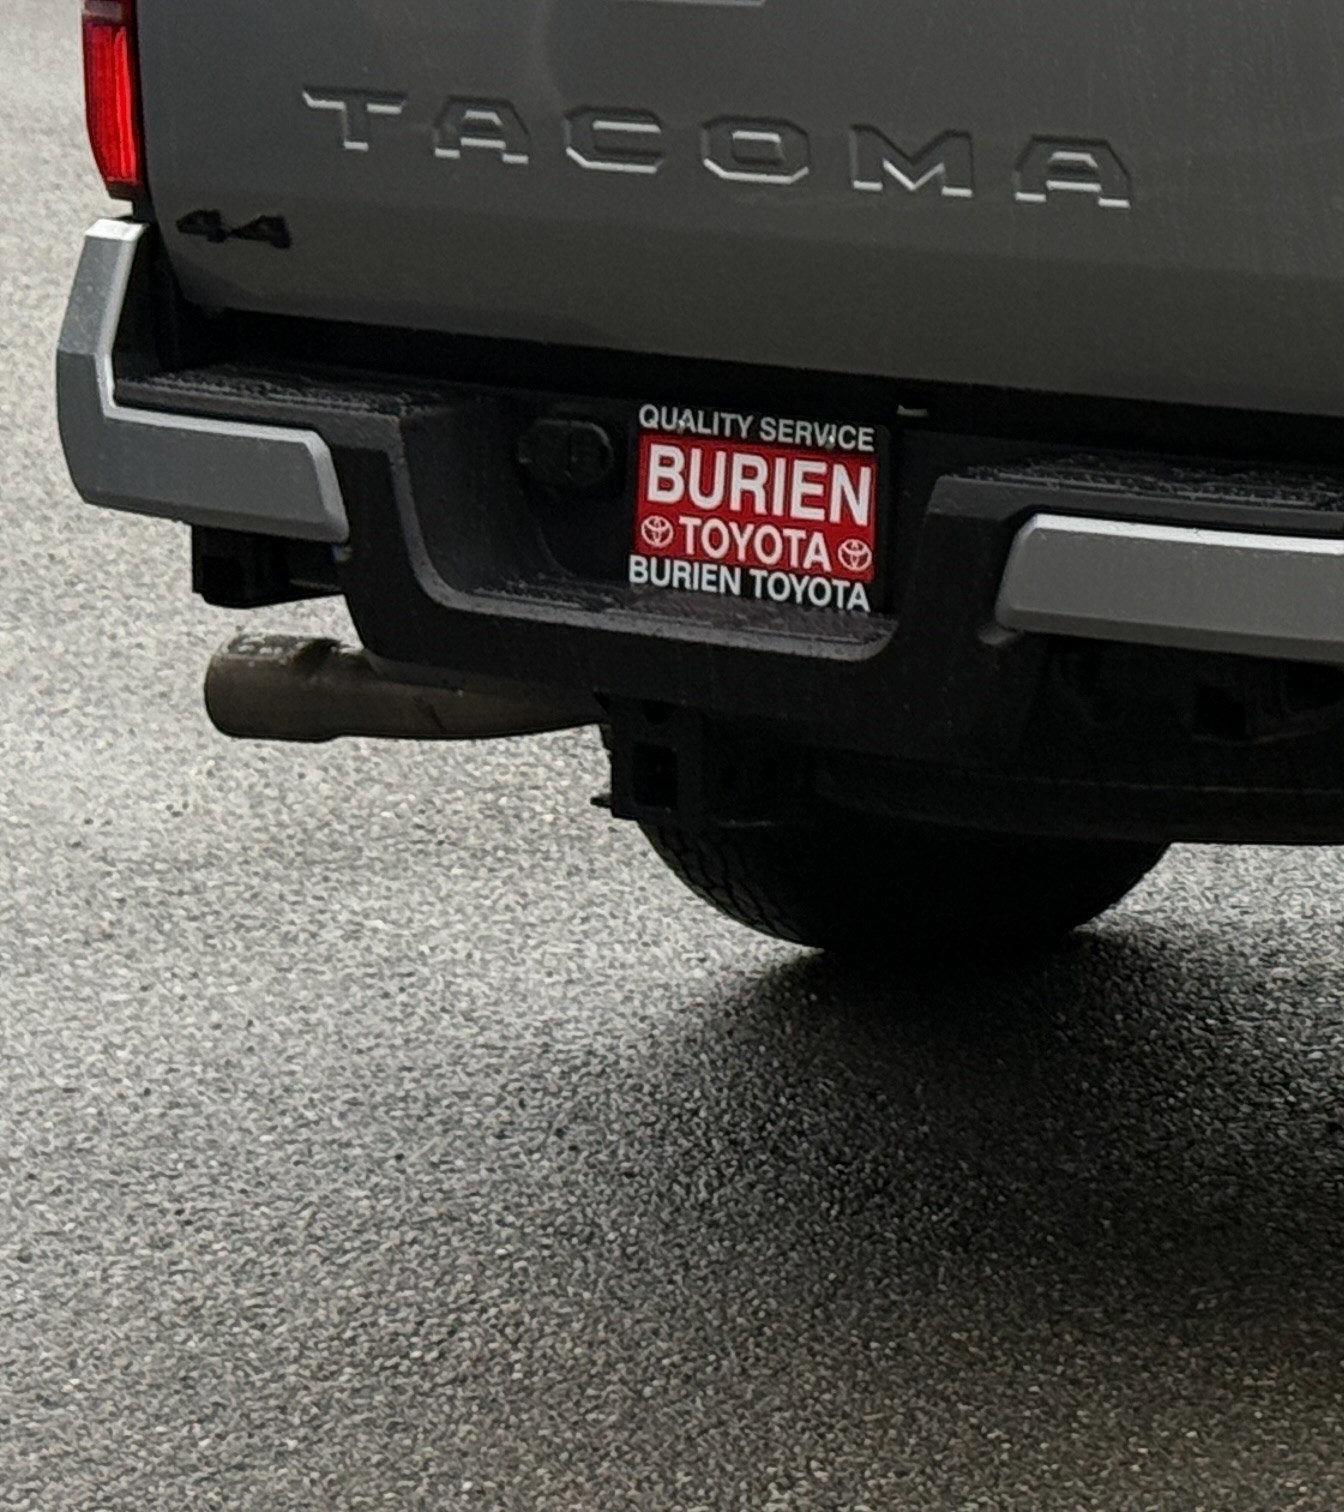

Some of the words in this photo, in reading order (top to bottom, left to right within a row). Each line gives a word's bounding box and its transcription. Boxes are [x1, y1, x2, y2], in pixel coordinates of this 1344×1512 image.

[302, 88, 1132, 209] TACOMA
[638, 403, 754, 439] QUALITY
[759, 416, 875, 453] SERVICE
[646, 443, 873, 528] BURIEN
[677, 515, 832, 573] TOYOTA
[628, 554, 743, 596] BURIEN
[749, 568, 871, 613] TOYOTA
